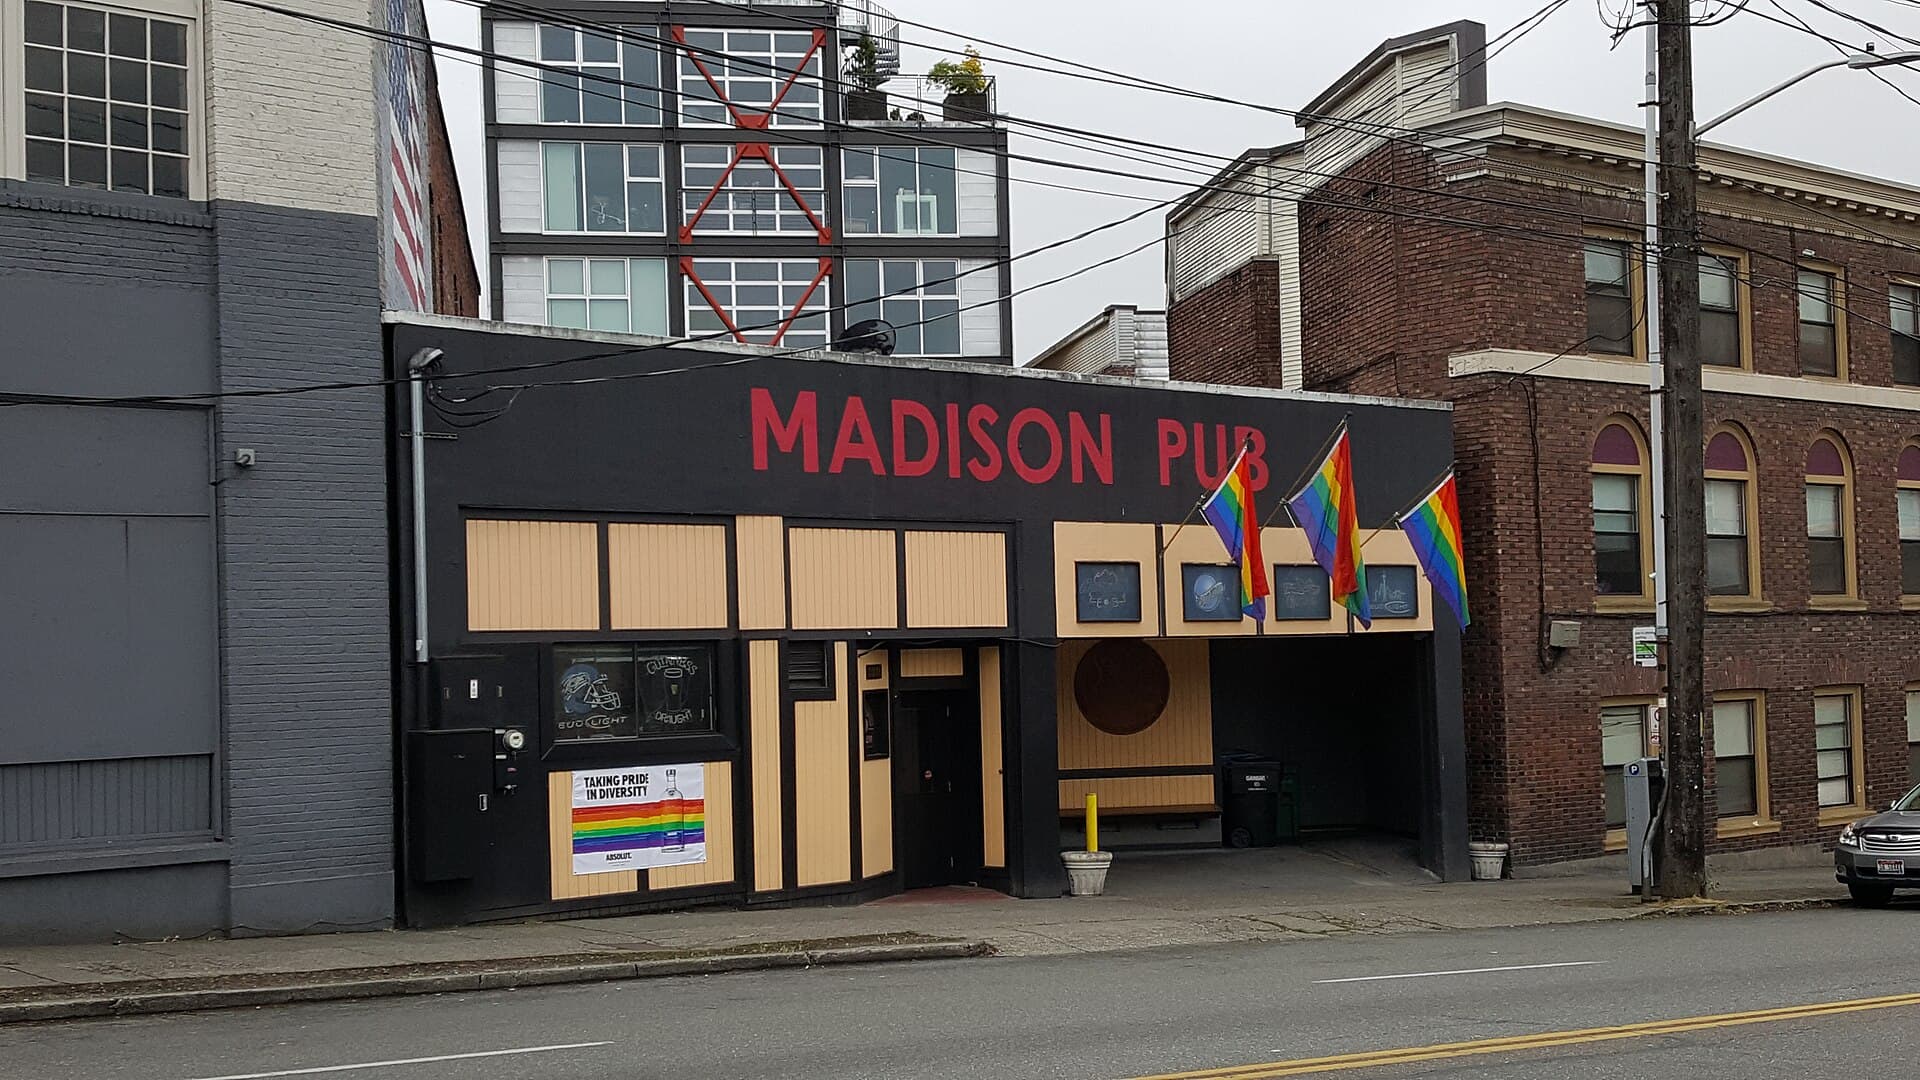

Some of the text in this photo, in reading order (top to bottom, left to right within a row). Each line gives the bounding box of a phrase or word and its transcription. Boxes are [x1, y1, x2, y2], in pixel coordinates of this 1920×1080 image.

[750, 387, 1270, 491] MADISON PUB
[646, 657, 698, 675] GUINNESS
[591, 716, 628, 726] LIGHT
[583, 773, 649, 788] TAKING PRIDE
[586, 785, 648, 800] IN DIVERSITY
